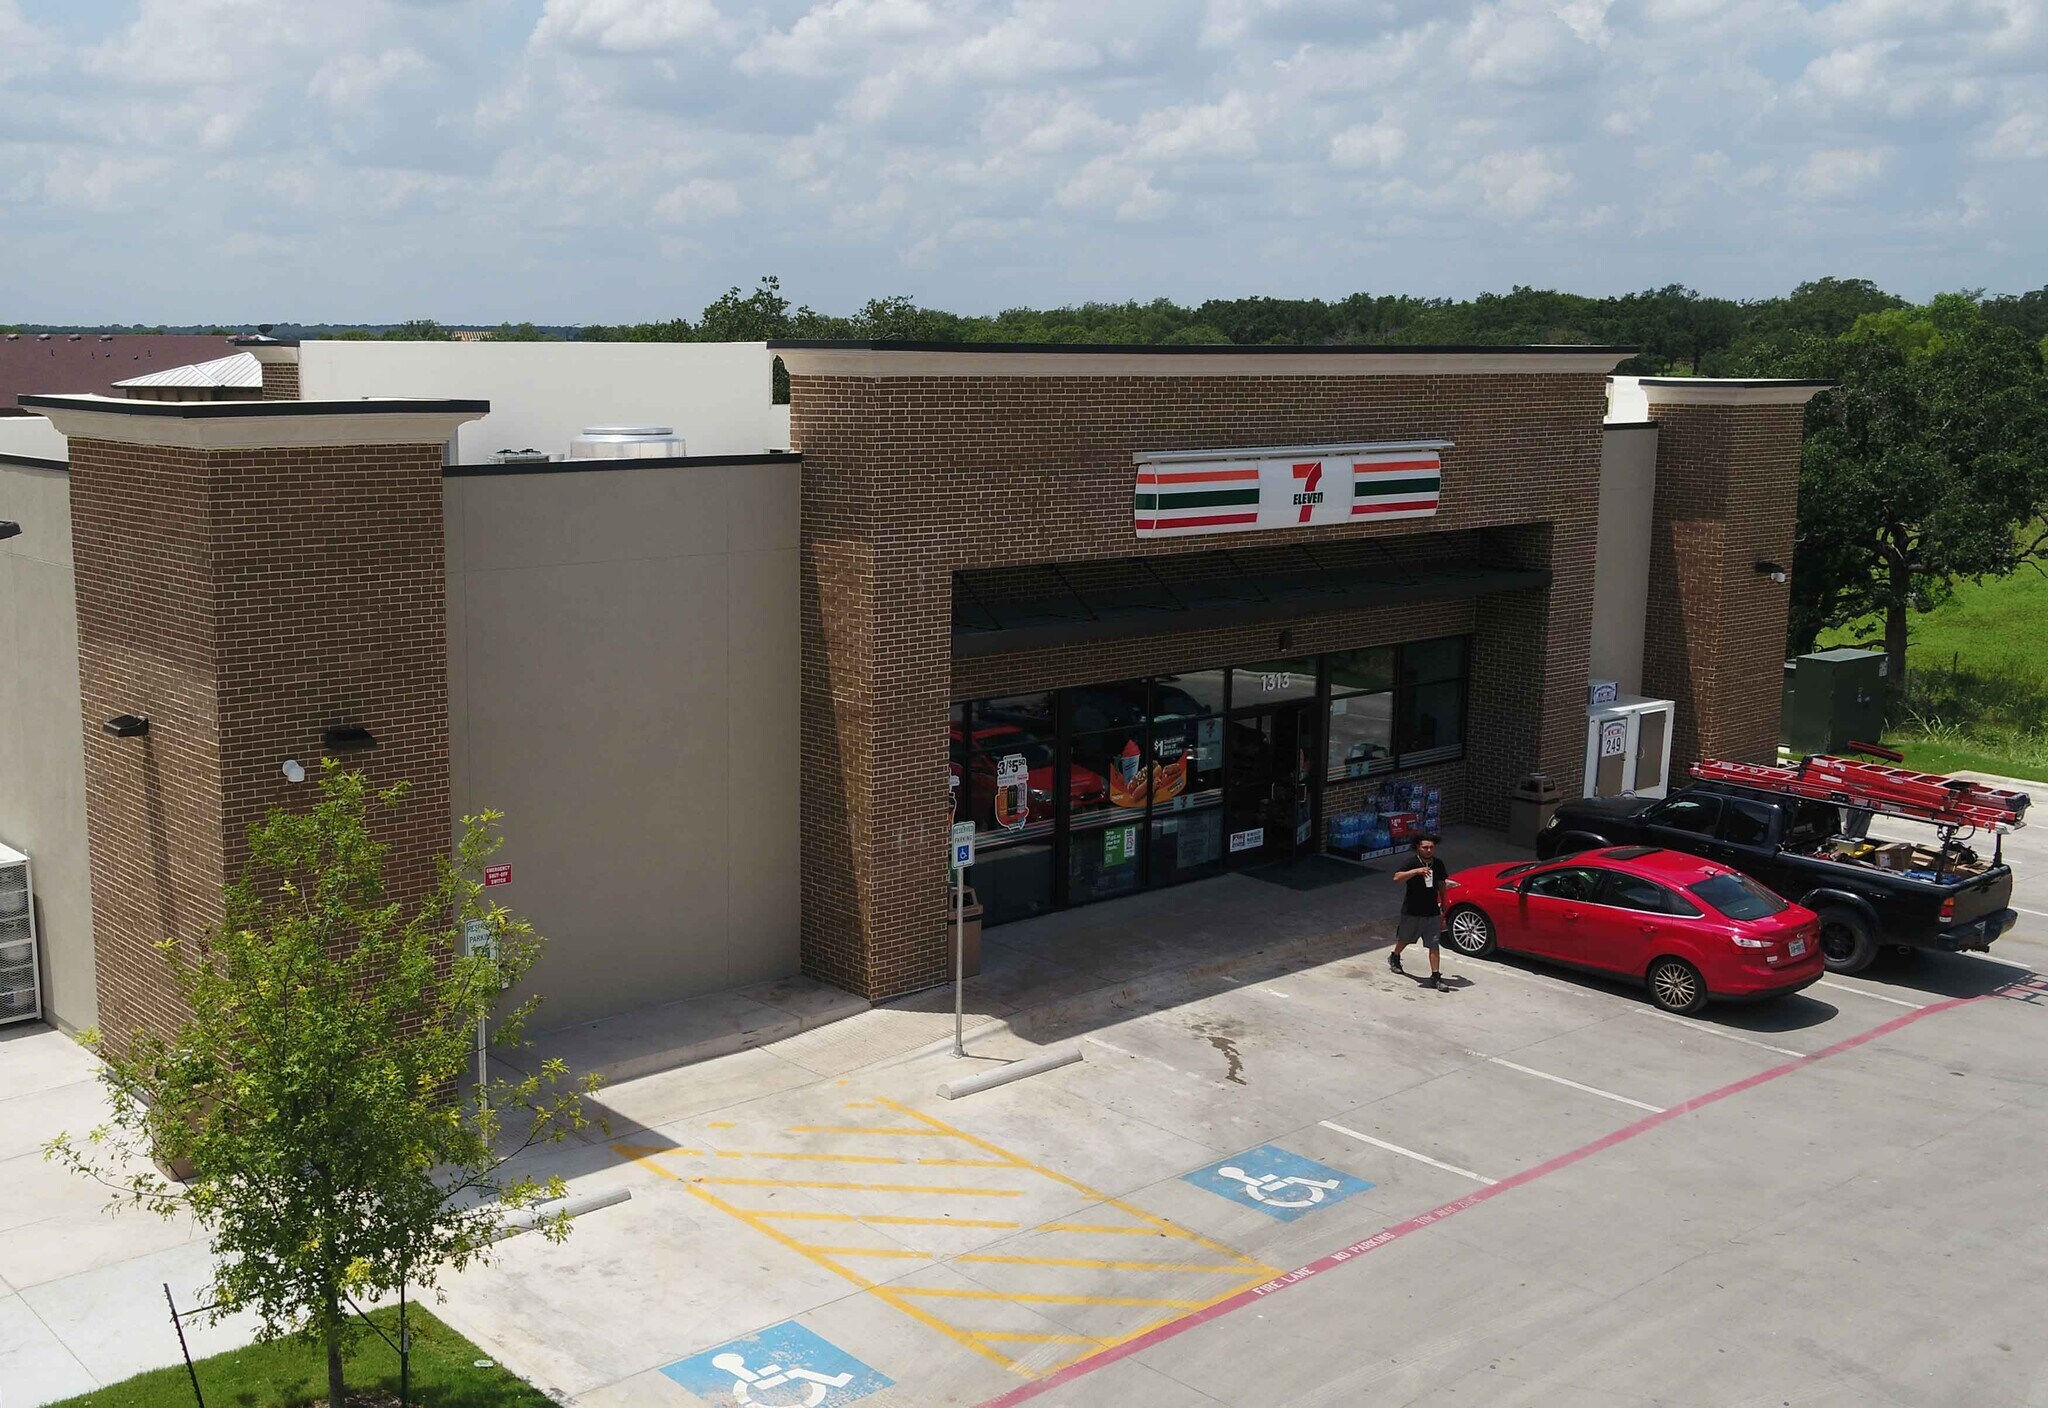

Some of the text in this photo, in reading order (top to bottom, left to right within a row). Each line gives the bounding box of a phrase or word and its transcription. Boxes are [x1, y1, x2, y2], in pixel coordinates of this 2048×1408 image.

[1293, 461, 1322, 522] 7
[1261, 672, 1290, 691] 1313
[1606, 737, 1620, 754] 249
[954, 835, 973, 843] PARKING
[490, 877, 507, 885] SWITCH
[1252, 1280, 1283, 1296] FIRE
[1281, 1267, 1315, 1282] LANE
[1330, 1251, 1351, 1261] NO
[1349, 1232, 1395, 1253] PARKING
[1413, 1215, 1437, 1225] TOW
